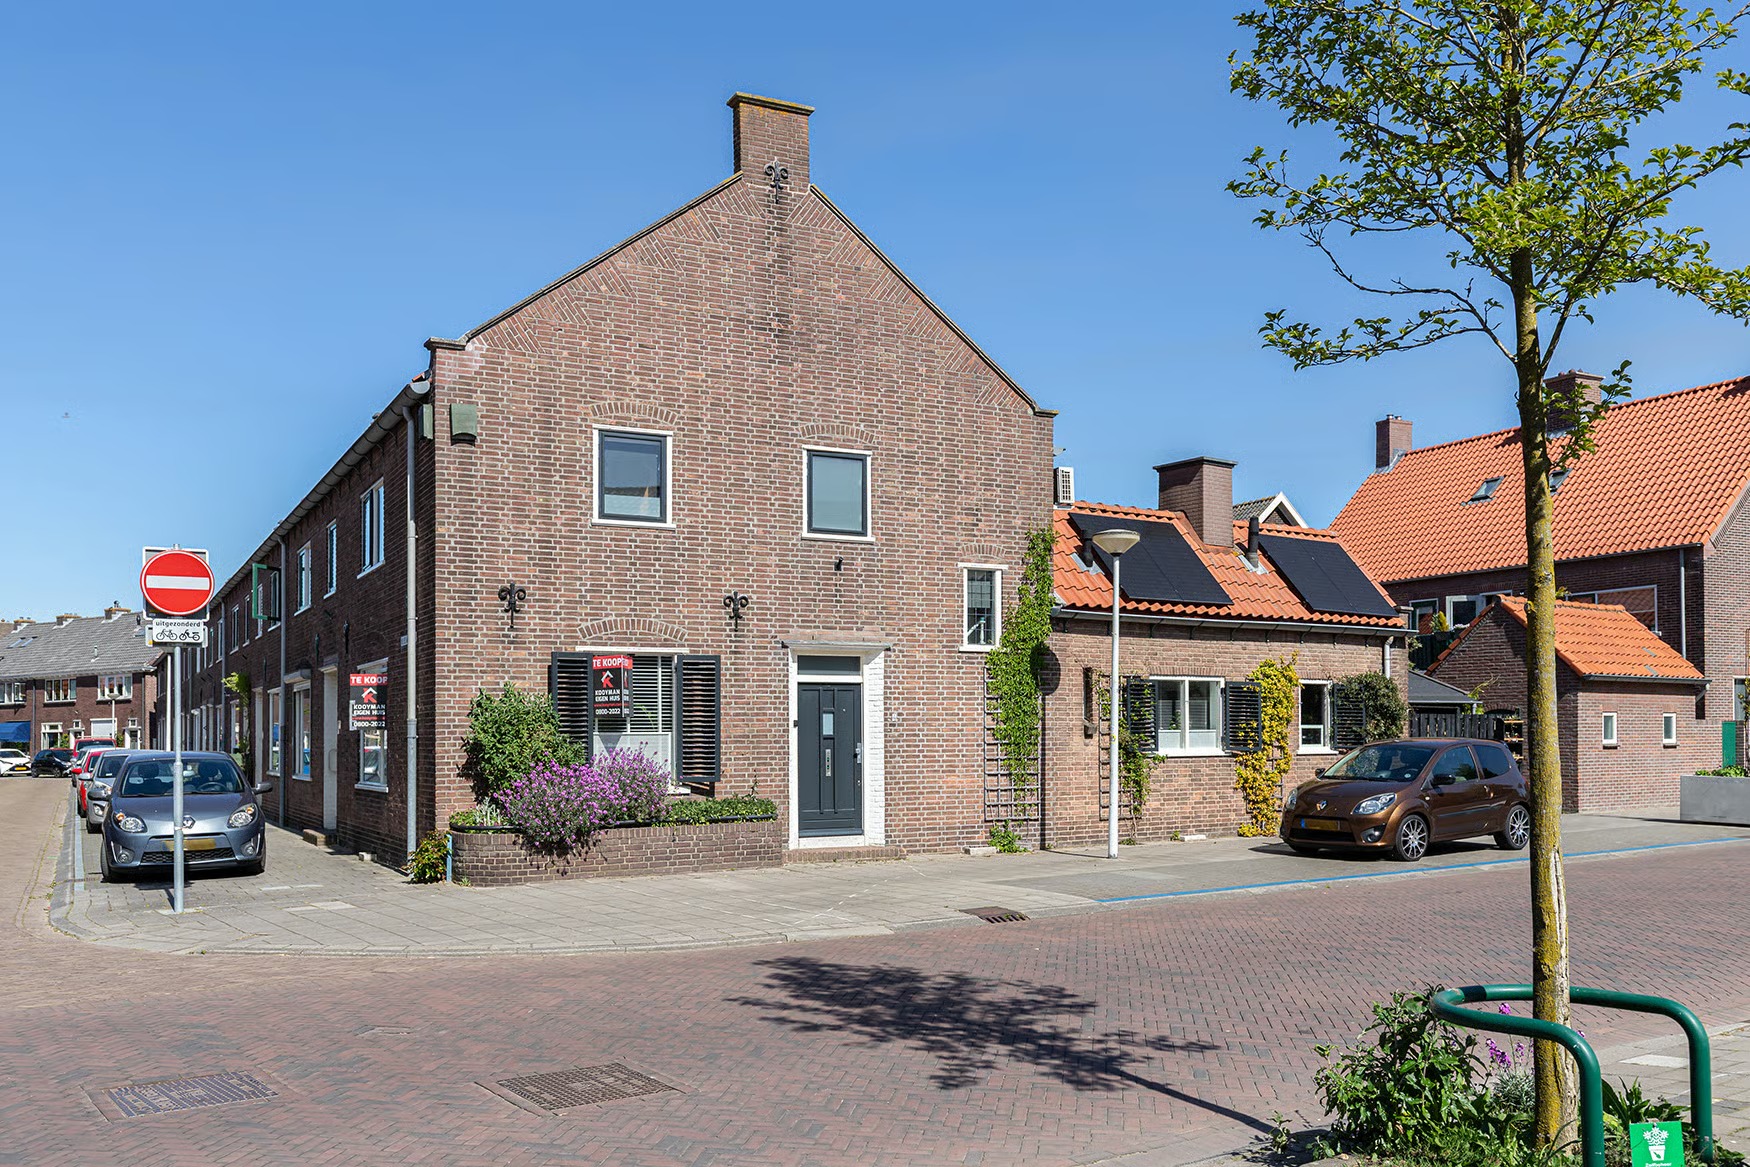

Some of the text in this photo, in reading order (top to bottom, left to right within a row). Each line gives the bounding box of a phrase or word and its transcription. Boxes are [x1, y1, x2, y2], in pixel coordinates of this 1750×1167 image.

[593, 659, 601, 667] TE
[602, 658, 622, 667] KOOP
[350, 676, 388, 684] TE KOOP
